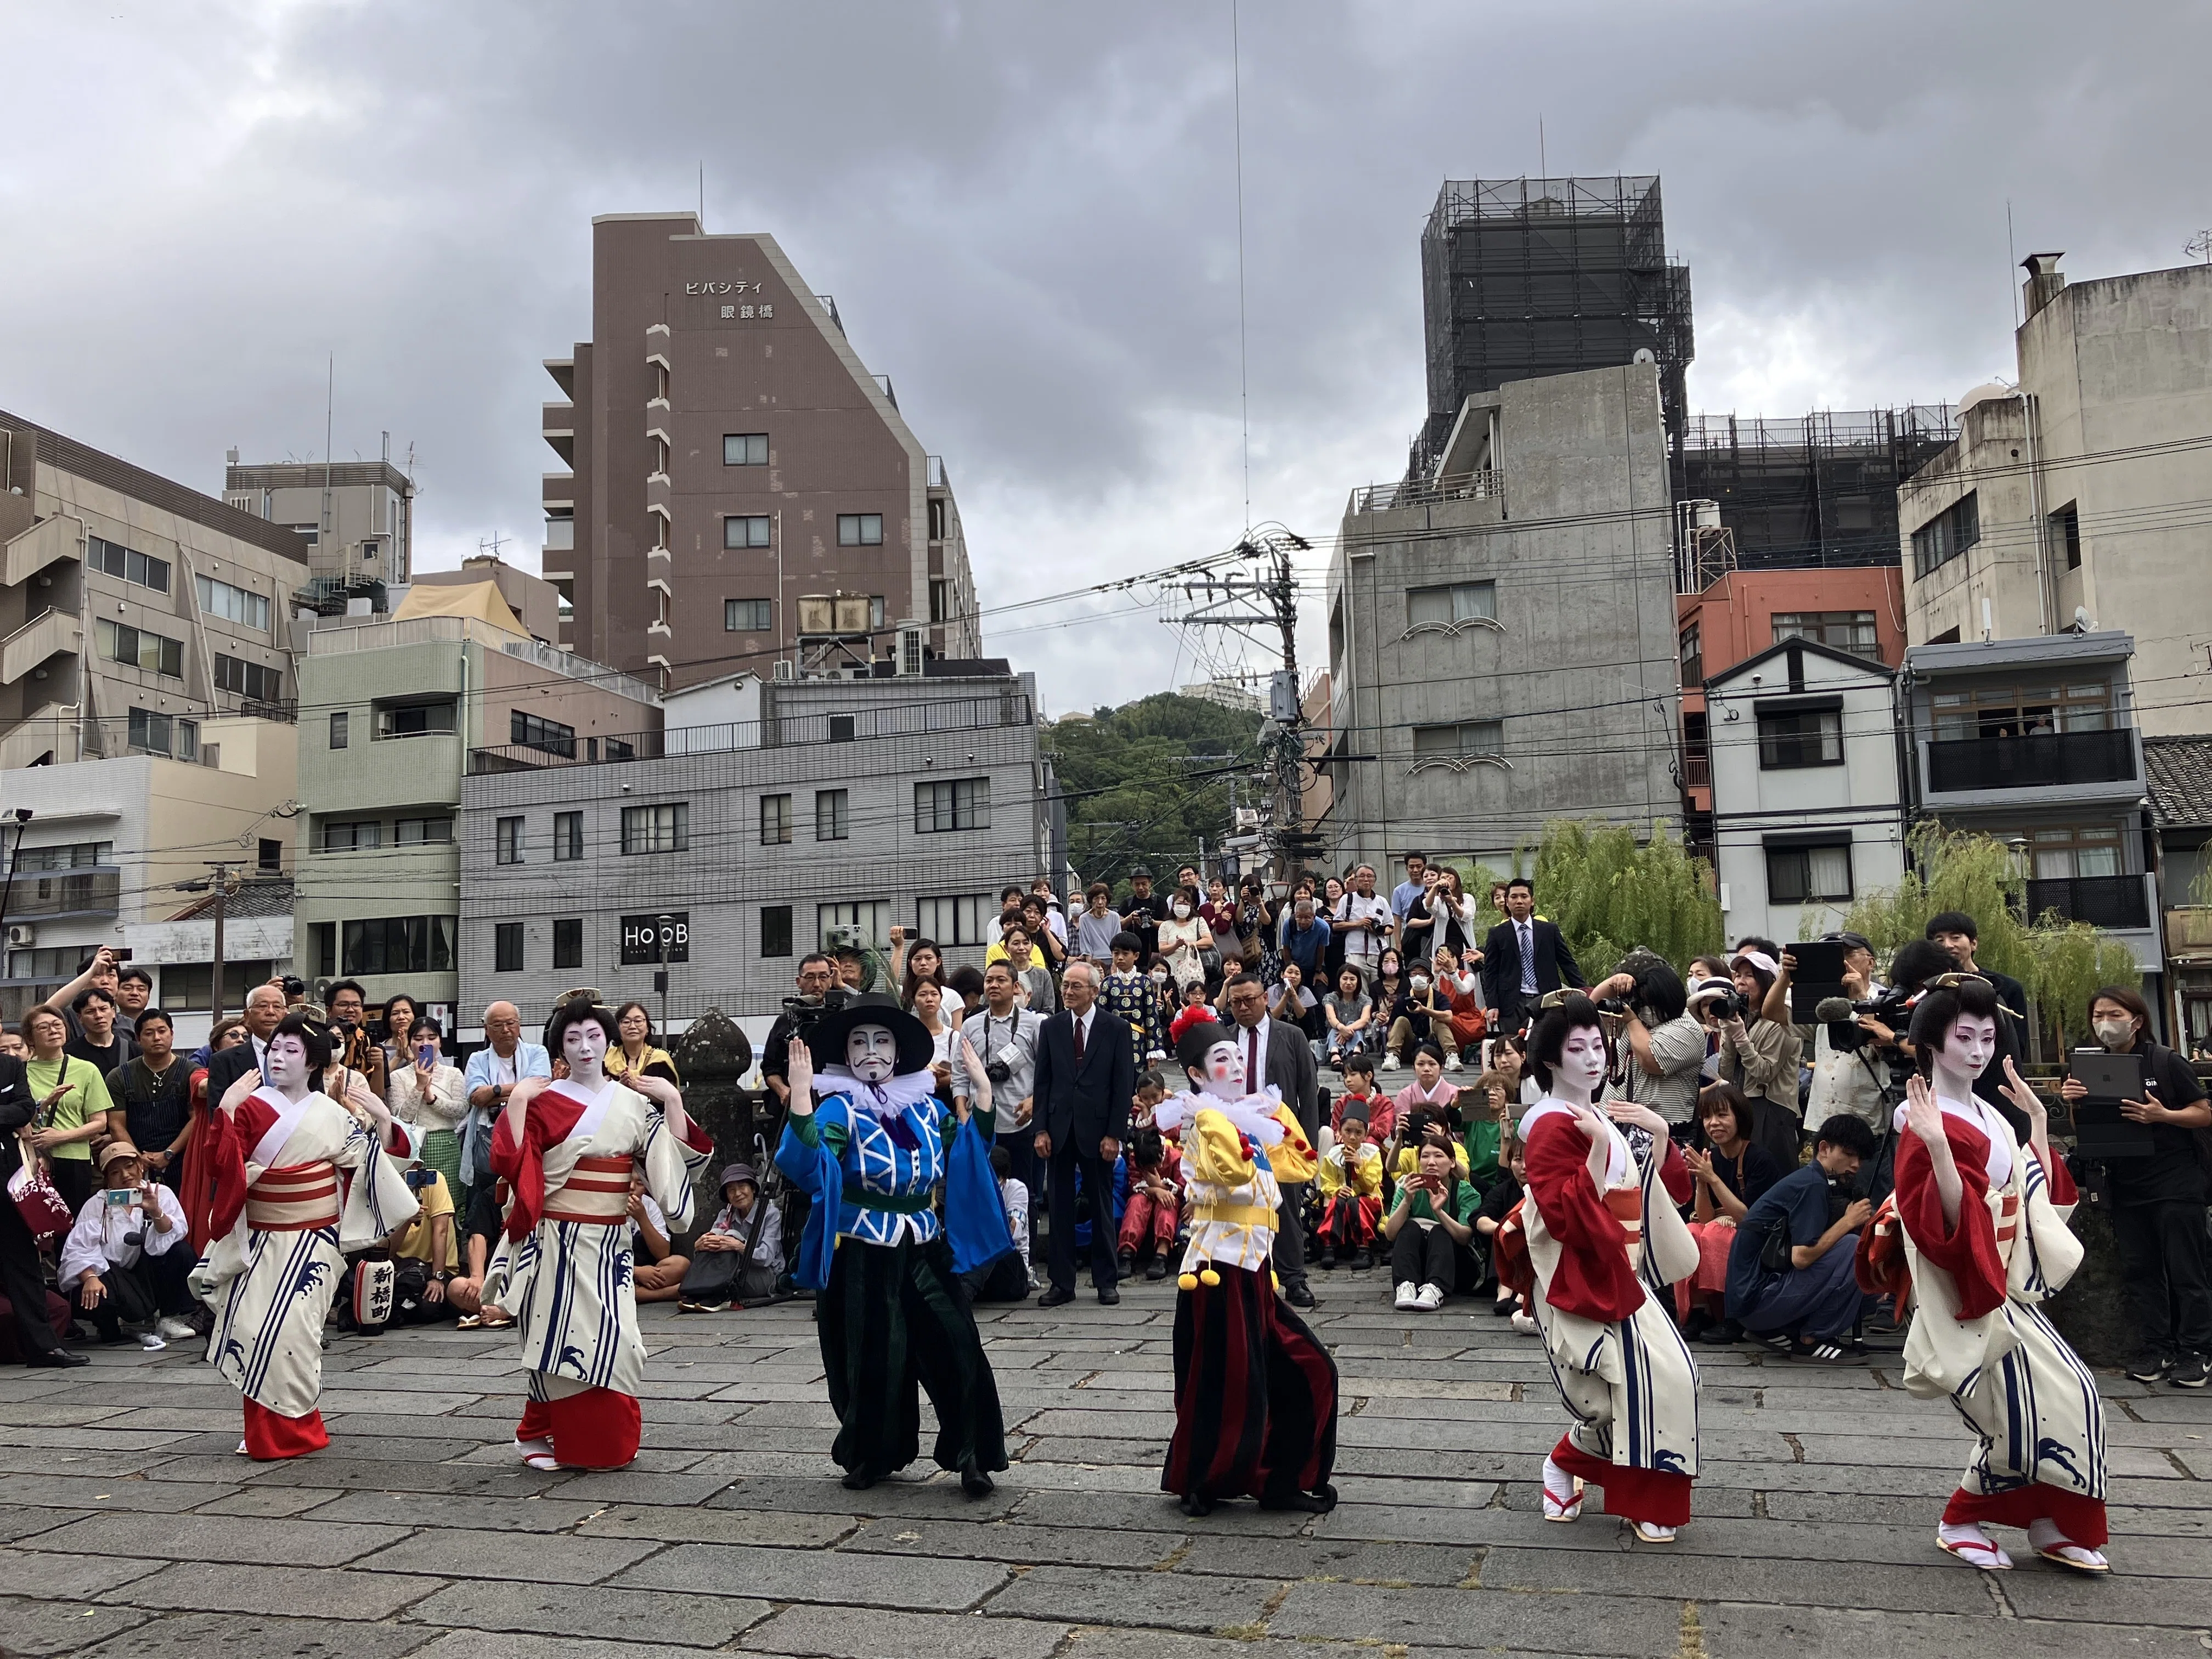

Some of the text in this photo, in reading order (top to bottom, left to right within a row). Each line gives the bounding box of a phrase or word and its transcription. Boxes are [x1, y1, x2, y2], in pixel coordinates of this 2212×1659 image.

[686, 281, 761, 295] ビバシティ
[721, 304, 773, 319] 眼鏡橋
[625, 924, 688, 946] HOOB
[370, 1266, 393, 1321] 新橋町
